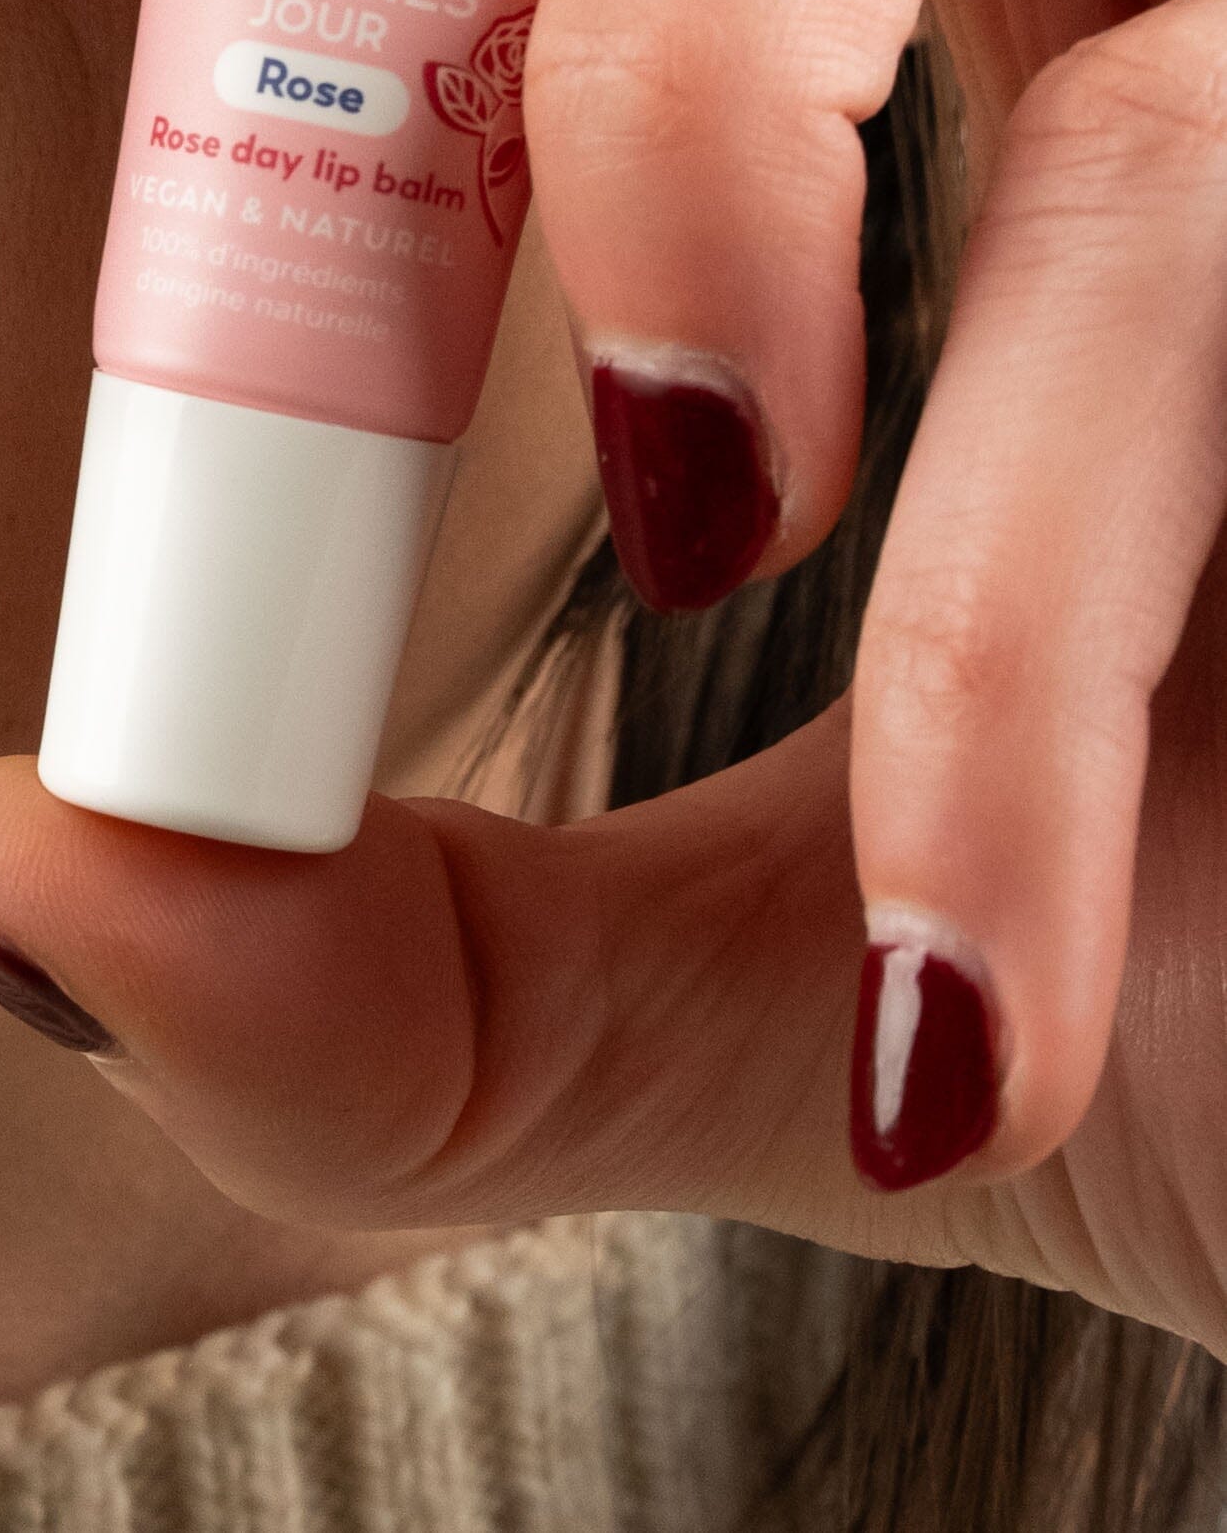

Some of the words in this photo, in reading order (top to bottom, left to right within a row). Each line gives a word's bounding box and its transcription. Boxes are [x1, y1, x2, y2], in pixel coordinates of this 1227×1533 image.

[256, 57, 365, 113] Rose
[149, 116, 221, 159] Rose
[231, 133, 304, 181] day
[313, 149, 361, 192] lip
[372, 162, 466, 212] balm
[130, 173, 228, 218] VEGAN
[239, 196, 264, 225] &
[279, 204, 456, 267] NATUREL
[141, 225, 201, 261] 100%
[254, 296, 390, 343] naturelle
